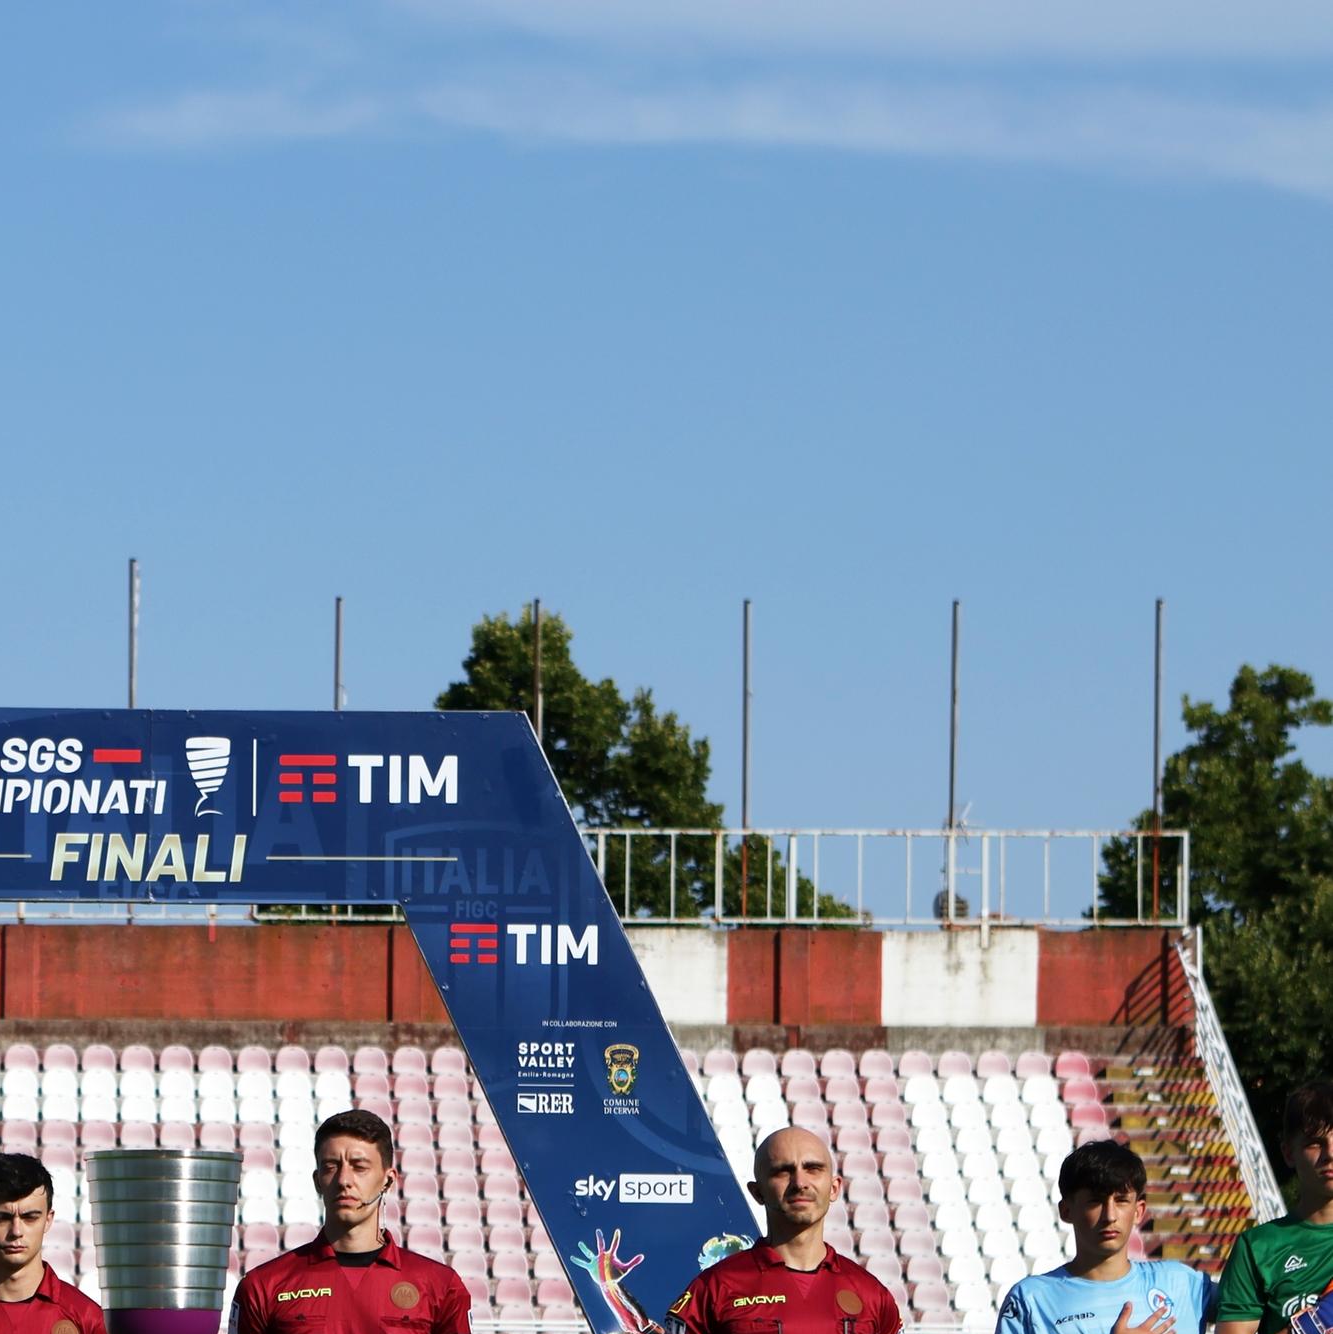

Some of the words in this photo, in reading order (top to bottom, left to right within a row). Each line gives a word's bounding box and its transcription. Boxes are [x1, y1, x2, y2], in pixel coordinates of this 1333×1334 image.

[0, 738, 82, 774] SGS
[348, 755, 458, 804] TIM
[50, 833, 247, 883] FINALI
[507, 924, 598, 966] TIM
[518, 1043, 575, 1055] SPORT
[518, 1056, 575, 1068] VALLEY
[603, 1099, 640, 1107] COMUNE
[603, 1107, 612, 1115] DI
[612, 1107, 640, 1115] CERVIA
[574, 1174, 616, 1200] sky
[624, 1177, 688, 1199] sport
[278, 1287, 332, 1302] GIVOVA
[733, 1295, 786, 1308] GIVOVA
